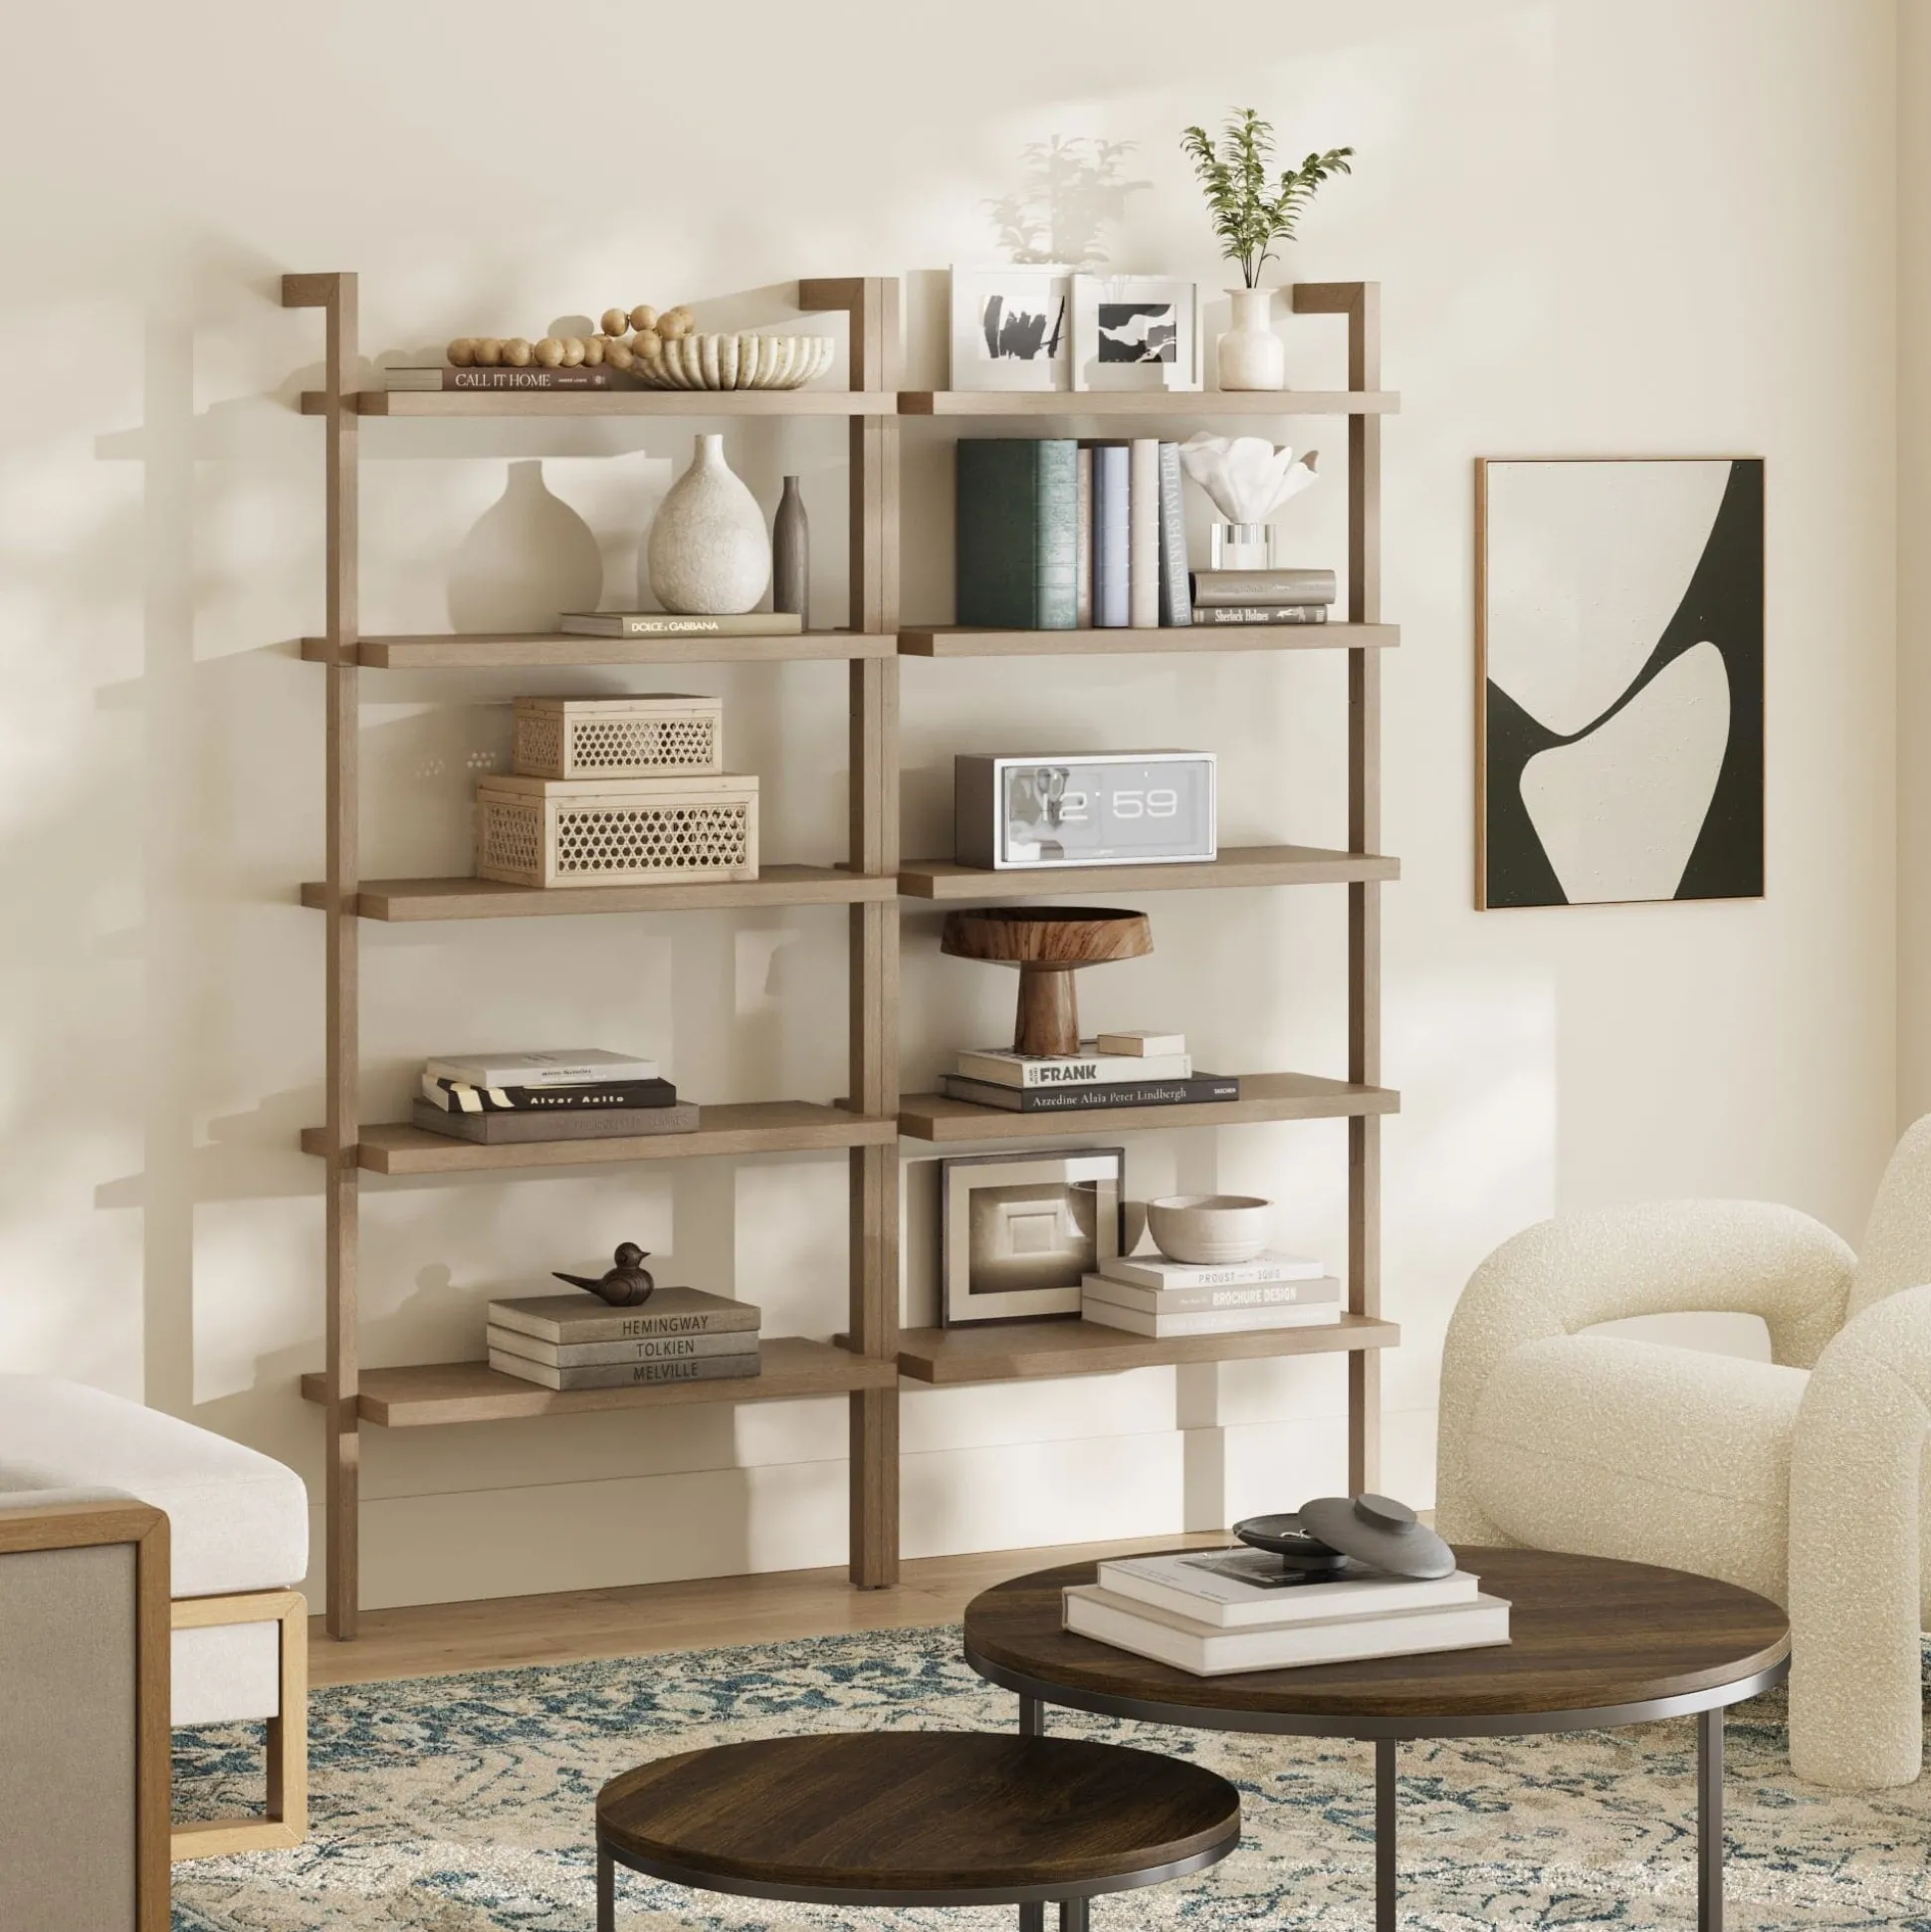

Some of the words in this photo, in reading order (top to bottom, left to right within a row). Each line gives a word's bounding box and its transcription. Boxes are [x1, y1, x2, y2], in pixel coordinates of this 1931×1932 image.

[455, 373, 491, 387] CALL
[494, 373, 507, 387] IT
[510, 373, 551, 387] HOME
[1163, 445, 1180, 516] WILLIAM
[1168, 519, 1187, 622] SHAKESPEARE
[1214, 608, 1243, 622] Sherlock
[1245, 608, 1269, 621] Holmes
[631, 622, 664, 632] DOLCE
[669, 621, 719, 631] GABBANA
[1113, 788, 1178, 818] 59
[1039, 1064, 1097, 1082] FRANK
[531, 1096, 573, 1105] Alvar
[1032, 1094, 1077, 1107] Azzedine
[1110, 1091, 1134, 1103] Peter
[1137, 1087, 1186, 1102] Lindbergh
[1198, 1271, 1235, 1284] PROUST
[1212, 1288, 1261, 1307] BROCHURE
[1264, 1286, 1296, 1302] DESIGN
[622, 1315, 709, 1336] HEMINGWAY
[636, 1340, 695, 1358] TOLKIEN
[633, 1362, 698, 1382] MELVILLE
